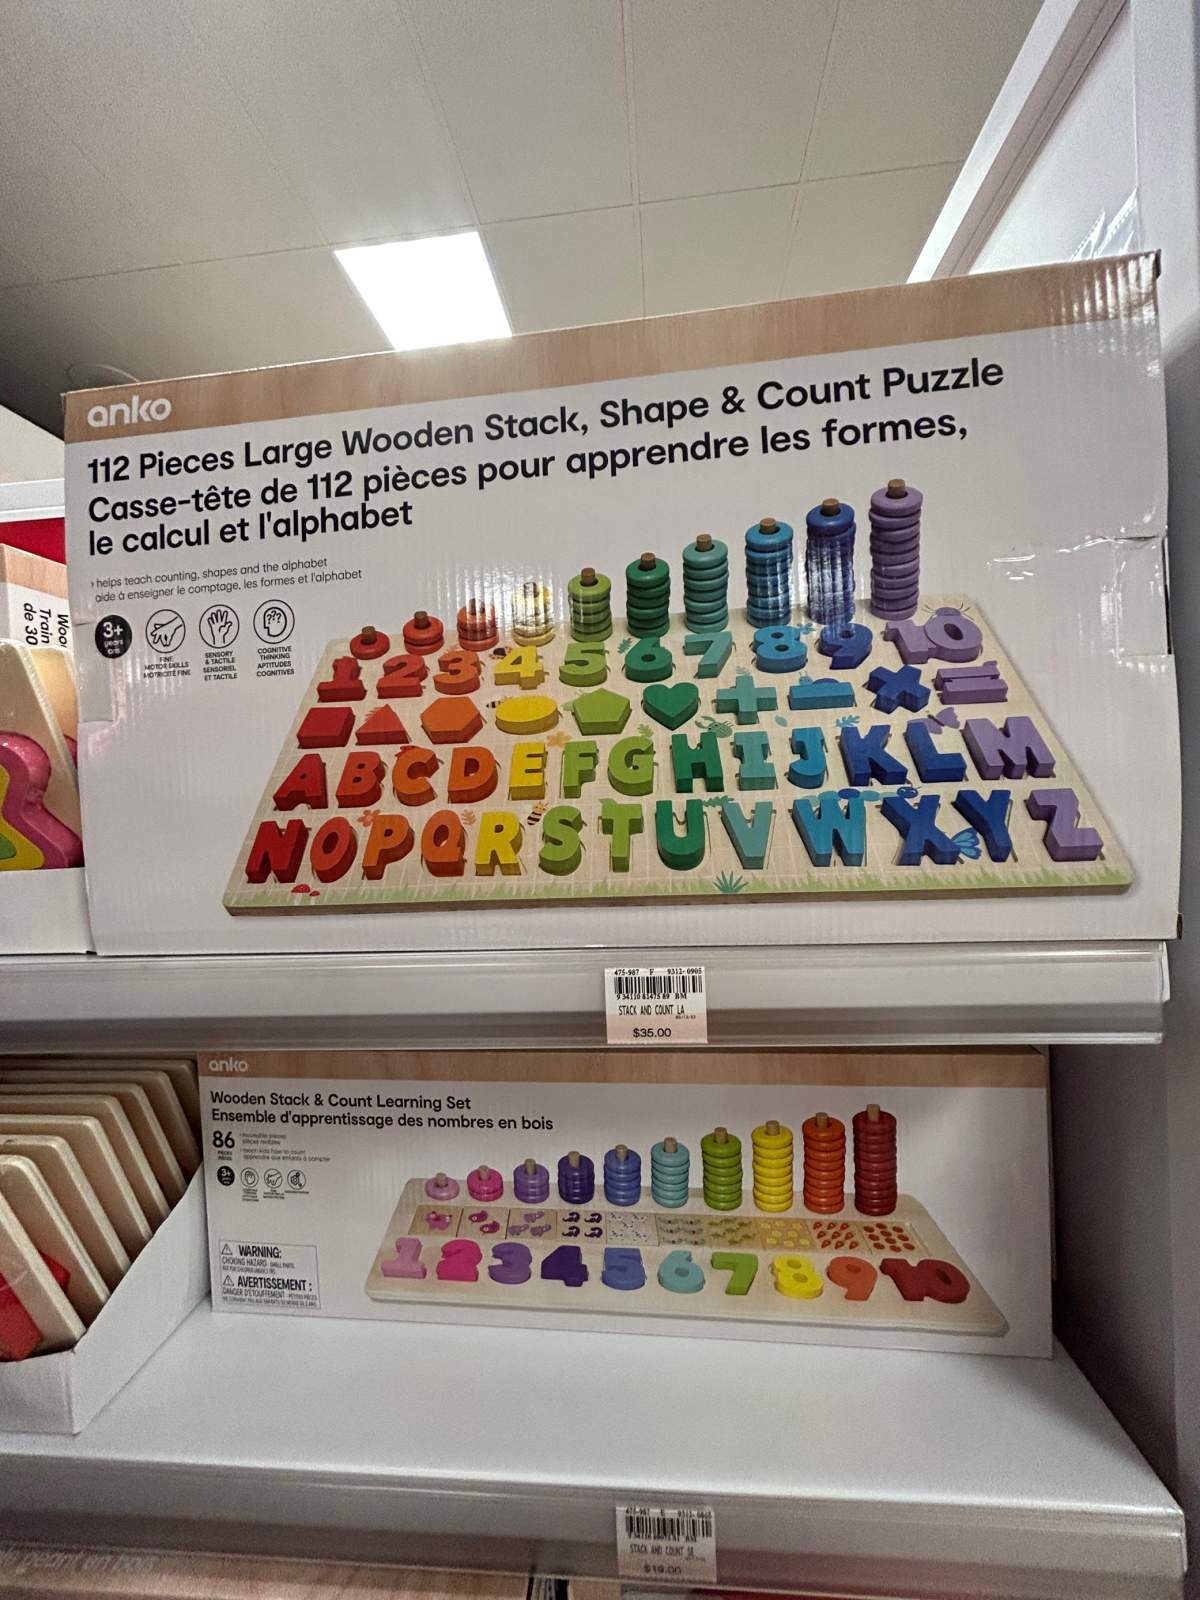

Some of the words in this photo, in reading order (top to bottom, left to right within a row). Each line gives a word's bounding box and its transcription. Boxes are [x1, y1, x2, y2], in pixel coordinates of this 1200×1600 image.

[87, 395, 172, 428] anko
[88, 455, 130, 483] 112
[140, 446, 234, 478] Pieces
[244, 435, 332, 468] Large
[342, 421, 474, 456] Wooden
[485, 406, 589, 441] Stack,
[600, 395, 709, 429] Shape
[721, 386, 745, 414] &
[757, 372, 871, 410] Count
[883, 357, 1004, 393] Puzzle
[89, 485, 251, 522] Casse-tête
[261, 478, 298, 504] de
[307, 470, 353, 500] 112
[363, 460, 466, 495] pièces
[479, 454, 555, 490] pour
[566, 431, 749, 479] apprendre
[761, 426, 811, 454] les
[823, 413, 968, 448] formes,
[90, 530, 113, 555] le
[122, 519, 209, 552] calcul
[218, 518, 250, 543] et
[259, 501, 413, 542] l'alphabet
[96, 578, 122, 588] helps
[125, 574, 152, 586] teach
[155, 570, 200, 582] counting,
[202, 567, 238, 579] shapes
[240, 563, 260, 574] and
[263, 562, 279, 572] the
[282, 558, 328, 572] alphabet
[95, 591, 116, 603] aide
[127, 587, 174, 599] enseigner
[177, 585, 185, 595] le
[243, 578, 258, 589] les
[260, 576, 295, 588] formes
[298, 575, 308, 584] et
[311, 569, 363, 584] l'alphabet
[24, 602, 36, 622] de
[25, 625, 38, 645] 30
[39, 608, 52, 644] Train
[57, 613, 69, 648] Woo
[103, 621, 124, 638] 3+
[257, 646, 292, 654] COGNITIVE
[260, 653, 290, 661] THINKING
[317, 655, 367, 703] 1
[376, 653, 429, 699] 2
[433, 650, 482, 696] 3
[494, 645, 544, 690] 4
[558, 642, 608, 687] 5
[624, 637, 673, 683] 6
[683, 631, 733, 679] 7
[752, 626, 808, 673] 8
[819, 622, 873, 669] 9
[884, 615, 983, 664] 10
[257, 661, 291, 669] APTITUDES
[257, 669, 295, 677] COGNITIVES
[273, 754, 328, 811] A
[336, 751, 386, 808] B
[392, 747, 439, 806] C
[447, 746, 499, 804] D
[508, 742, 547, 800] E
[562, 740, 598, 798] F
[607, 736, 655, 796] G
[671, 731, 724, 793] H
[734, 731, 776, 790] I
[788, 727, 826, 789] J
[840, 725, 908, 787] K
[904, 721, 967, 783] L
[963, 716, 1056, 780] M
[245, 818, 309, 883] N
[310, 816, 358, 883] O
[362, 814, 414, 880] P
[420, 809, 466, 877] Q
[475, 811, 523, 877] R
[539, 805, 583, 876] S
[601, 802, 644, 872] T
[656, 800, 706, 871] U
[721, 801, 773, 870] V
[792, 798, 866, 867] W
[880, 794, 960, 866] X
[954, 790, 1012, 862] Y
[1027, 788, 1101, 862] Z
[619, 1005, 637, 1015] STACK
[640, 1005, 652, 1015] AND
[655, 1004, 674, 1015] COUNT
[677, 1004, 685, 1015] LA
[633, 1028, 672, 1038] $35.00
[209, 1057, 248, 1072] anko
[210, 1090, 266, 1105] Wooden
[270, 1093, 310, 1106] Stack
[315, 1094, 324, 1106] &
[328, 1094, 373, 1107] Count
[377, 1095, 441, 1112] Learning
[446, 1096, 471, 1109] Set
[212, 1109, 276, 1123] Ensemble
[280, 1111, 393, 1129] d'apprentissage
[398, 1113, 423, 1127] des
[428, 1115, 493, 1129] nombres
[498, 1118, 517, 1129] en
[522, 1116, 553, 1130] bois
[213, 1130, 235, 1148] 86
[239, 1245, 282, 1259] WARNING:
[381, 1237, 427, 1280] 1
[436, 1239, 483, 1282] 2
[488, 1242, 532, 1285] 3
[540, 1245, 588, 1288] 4
[602, 1246, 645, 1290] 5
[658, 1250, 705, 1294] 6
[711, 1251, 758, 1296] 7
[772, 1254, 824, 1300] 8
[828, 1256, 878, 1301] 9
[880, 1257, 971, 1304] 10
